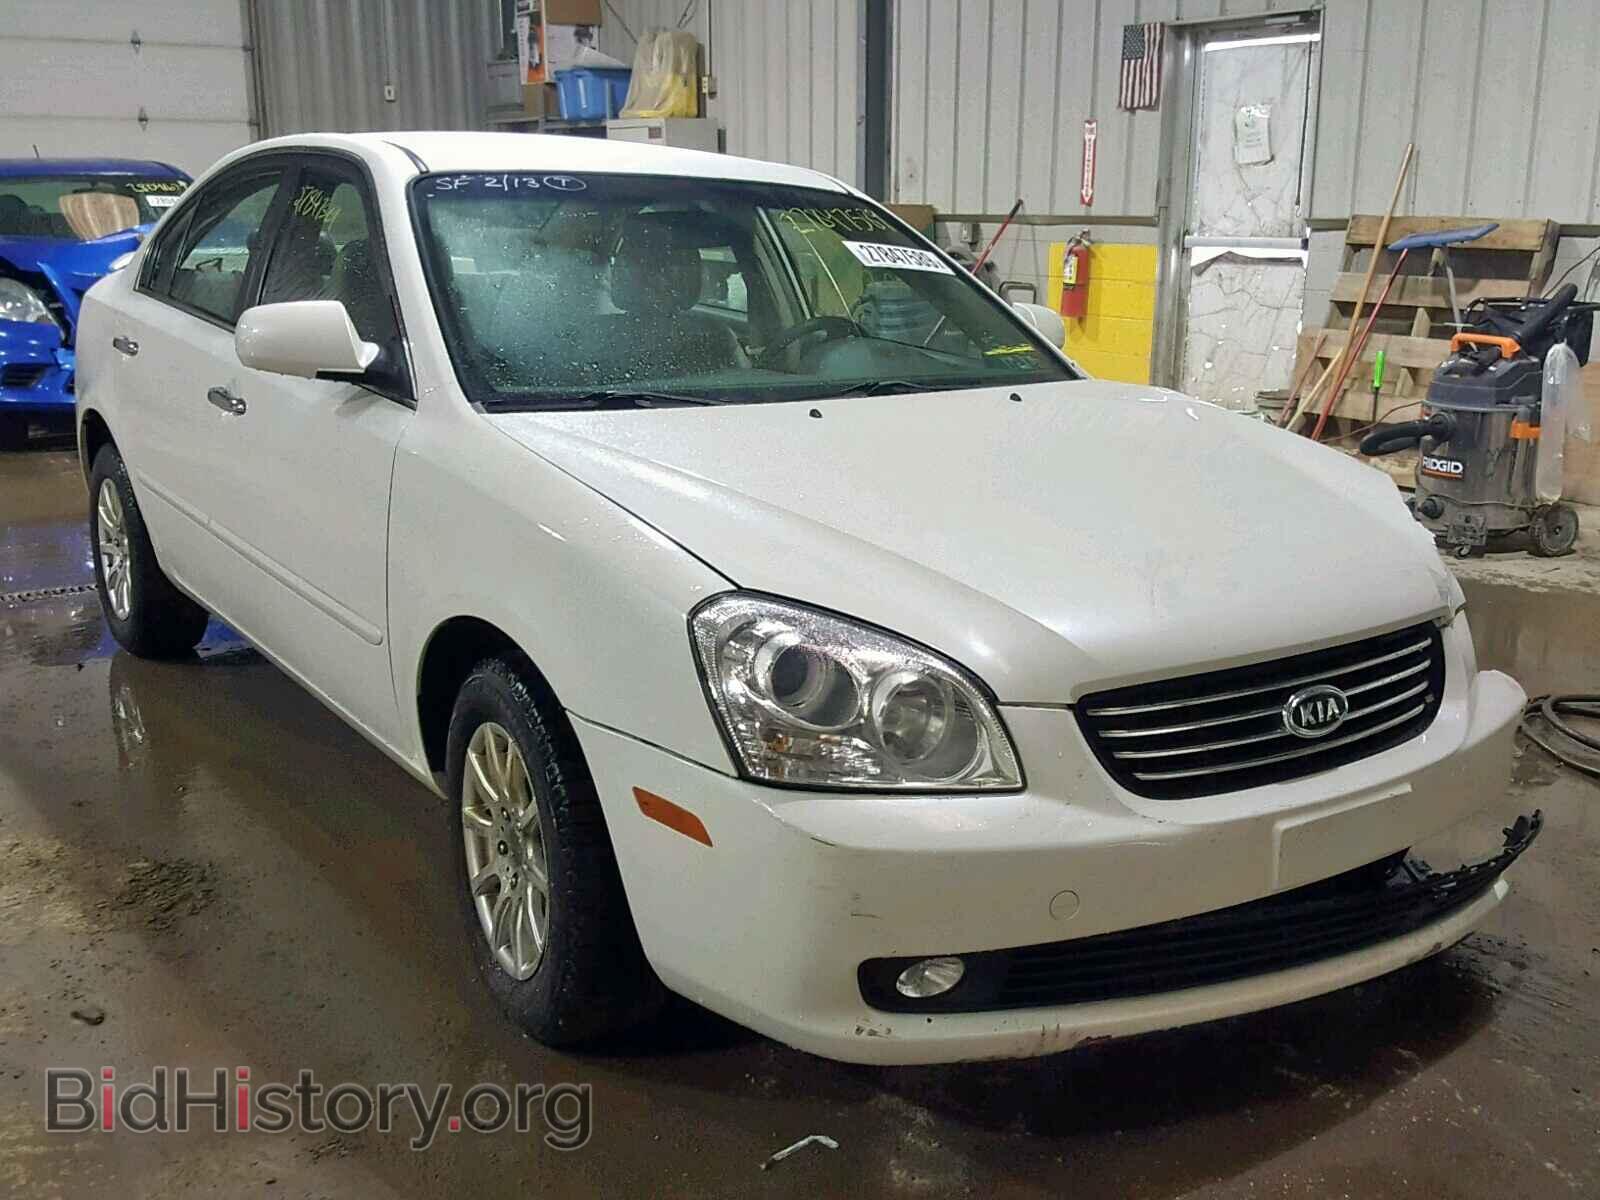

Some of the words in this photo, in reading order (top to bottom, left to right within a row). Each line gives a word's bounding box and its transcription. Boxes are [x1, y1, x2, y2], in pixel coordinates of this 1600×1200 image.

[485, 174, 540, 192] 2/13
[1423, 455, 1464, 474] RIDGID
[1299, 697, 1341, 728] KIA
